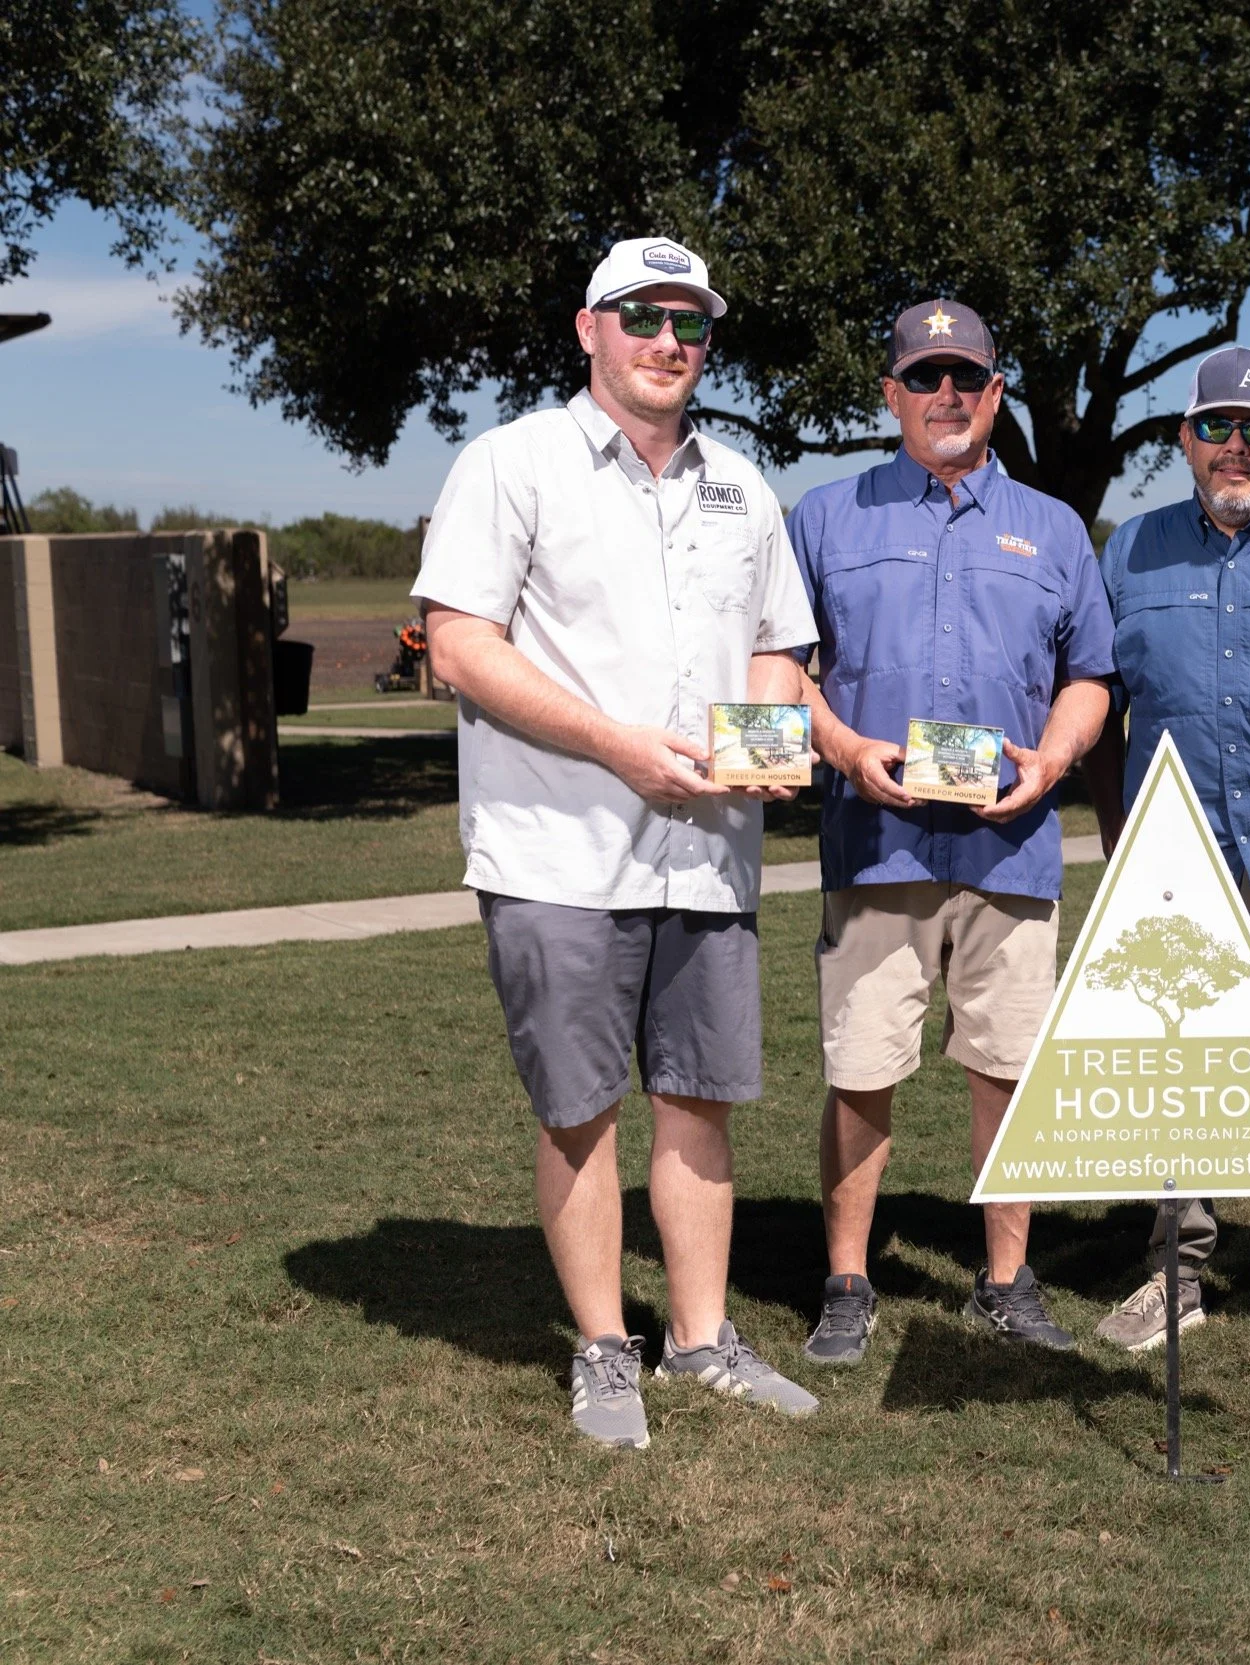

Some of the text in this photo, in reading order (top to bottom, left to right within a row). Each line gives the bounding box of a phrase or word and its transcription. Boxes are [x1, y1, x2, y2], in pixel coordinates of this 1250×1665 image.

[668, 254, 686, 264] Roja
[699, 484, 742, 504] ROMCO
[913, 786, 987, 800] TREES FOR HOUSTON
[1056, 1048, 1184, 1076] TREES
[1034, 1130, 1045, 1142] A
[1053, 1128, 1161, 1142] NONPROFIT
